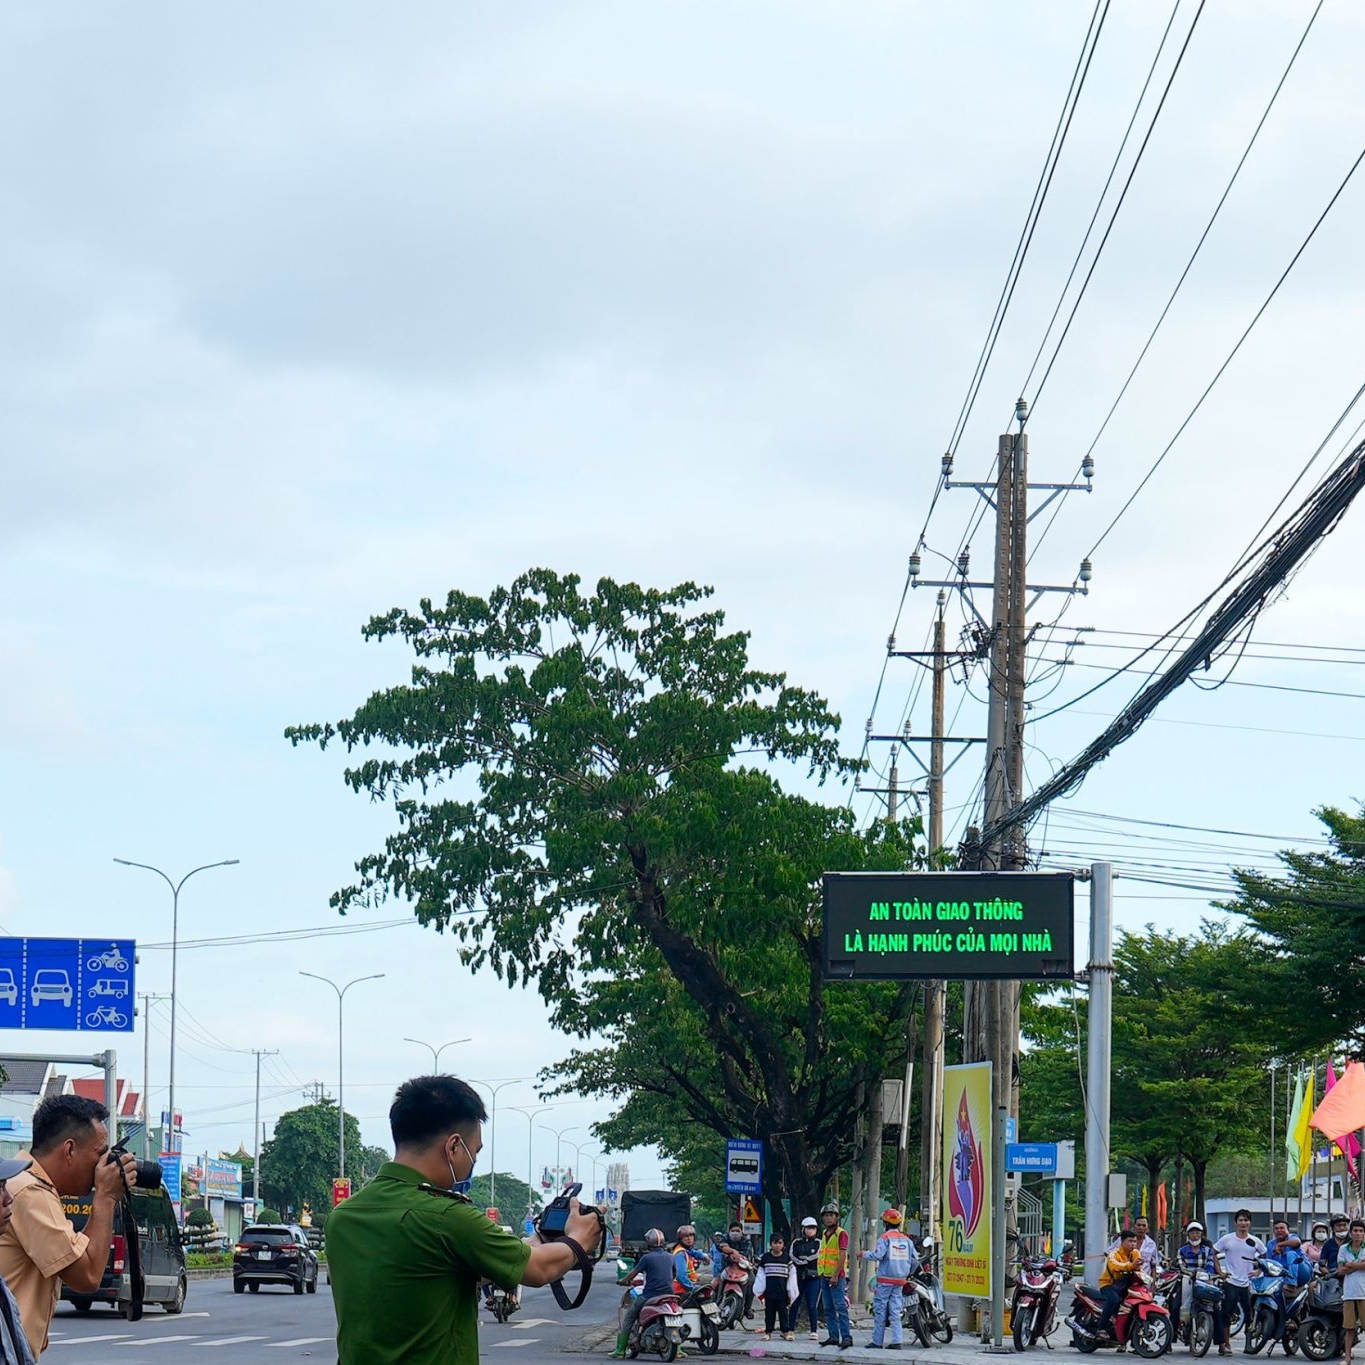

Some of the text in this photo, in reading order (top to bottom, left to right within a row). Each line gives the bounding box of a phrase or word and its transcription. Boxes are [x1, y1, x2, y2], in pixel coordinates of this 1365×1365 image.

[869, 897, 1023, 920] AN TOÀN GIAO THÔNG
[844, 926, 1052, 956] LÀ HẠNH PHÚC CỦA MỌI NHÀ
[948, 1220, 963, 1253] 76
